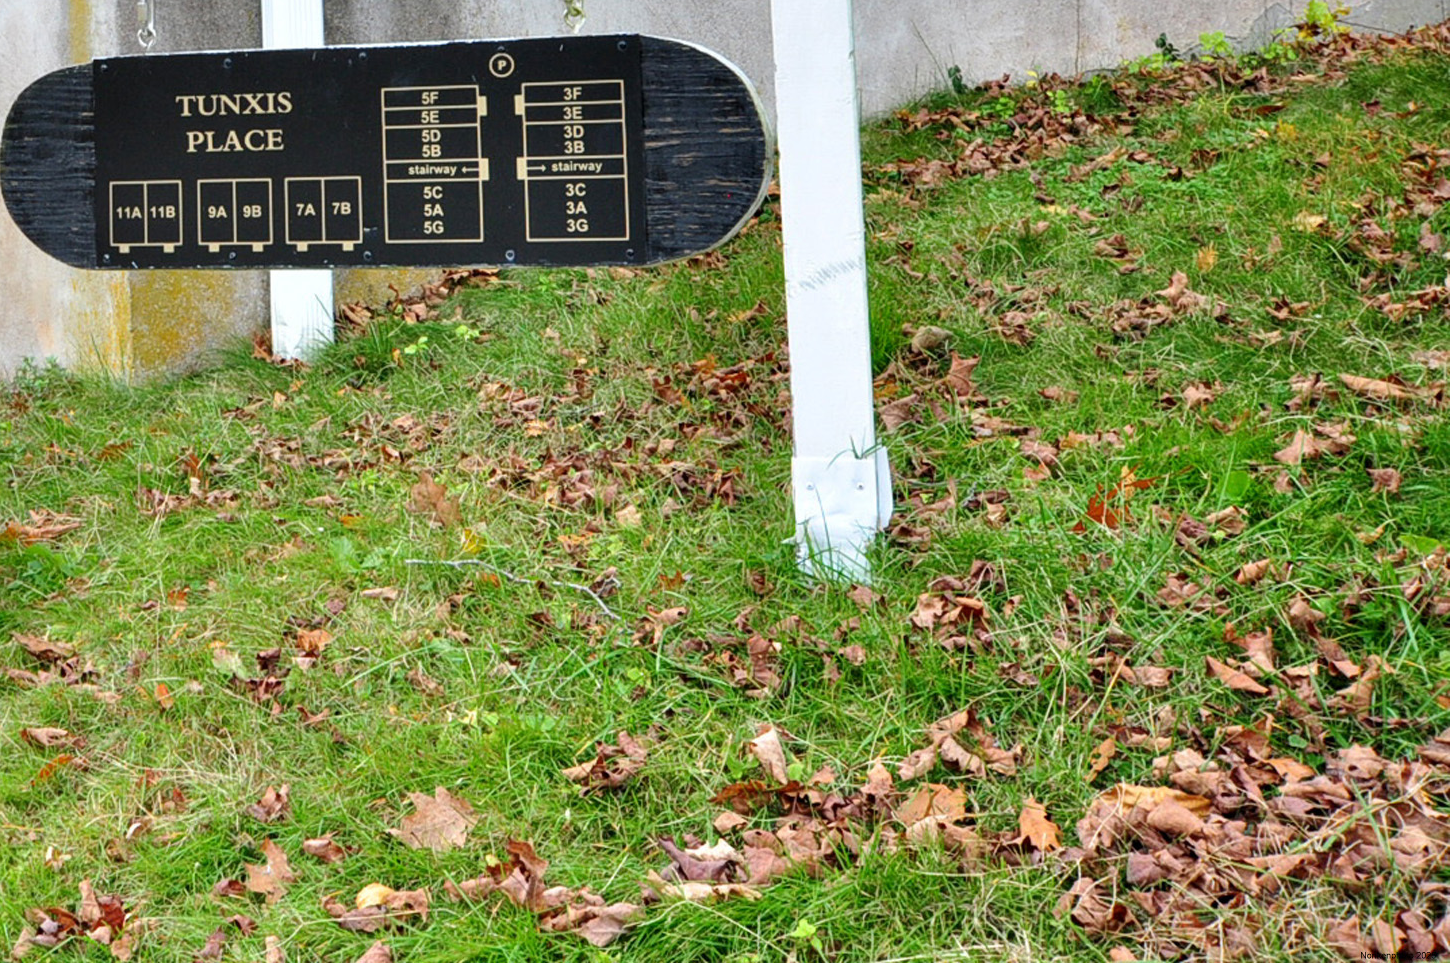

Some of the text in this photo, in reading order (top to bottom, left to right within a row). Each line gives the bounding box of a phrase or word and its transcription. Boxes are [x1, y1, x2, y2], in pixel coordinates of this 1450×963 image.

[422, 92, 439, 105] 5F
[563, 87, 582, 100] 3F
[176, 92, 293, 117] TUNXIS
[421, 111, 439, 123] 5E
[563, 107, 582, 119] 3E
[422, 129, 441, 142] 5D
[564, 126, 584, 139] 3D
[186, 129, 284, 153] PLACE
[564, 141, 584, 153] 3B
[422, 145, 441, 157] 5B
[408, 164, 457, 177] stairway
[551, 160, 602, 174] stairway
[423, 186, 443, 199] 5C
[565, 183, 586, 197] 3C
[116, 206, 142, 219] 11A
[150, 205, 175, 219] 11B
[208, 205, 228, 219] 9A
[243, 205, 262, 218] 9B
[296, 203, 316, 216] 7A
[332, 202, 351, 215] 7B
[424, 204, 444, 217] 5A
[566, 201, 587, 214] 3A
[423, 220, 444, 233] 5G
[566, 219, 588, 232] 3G
